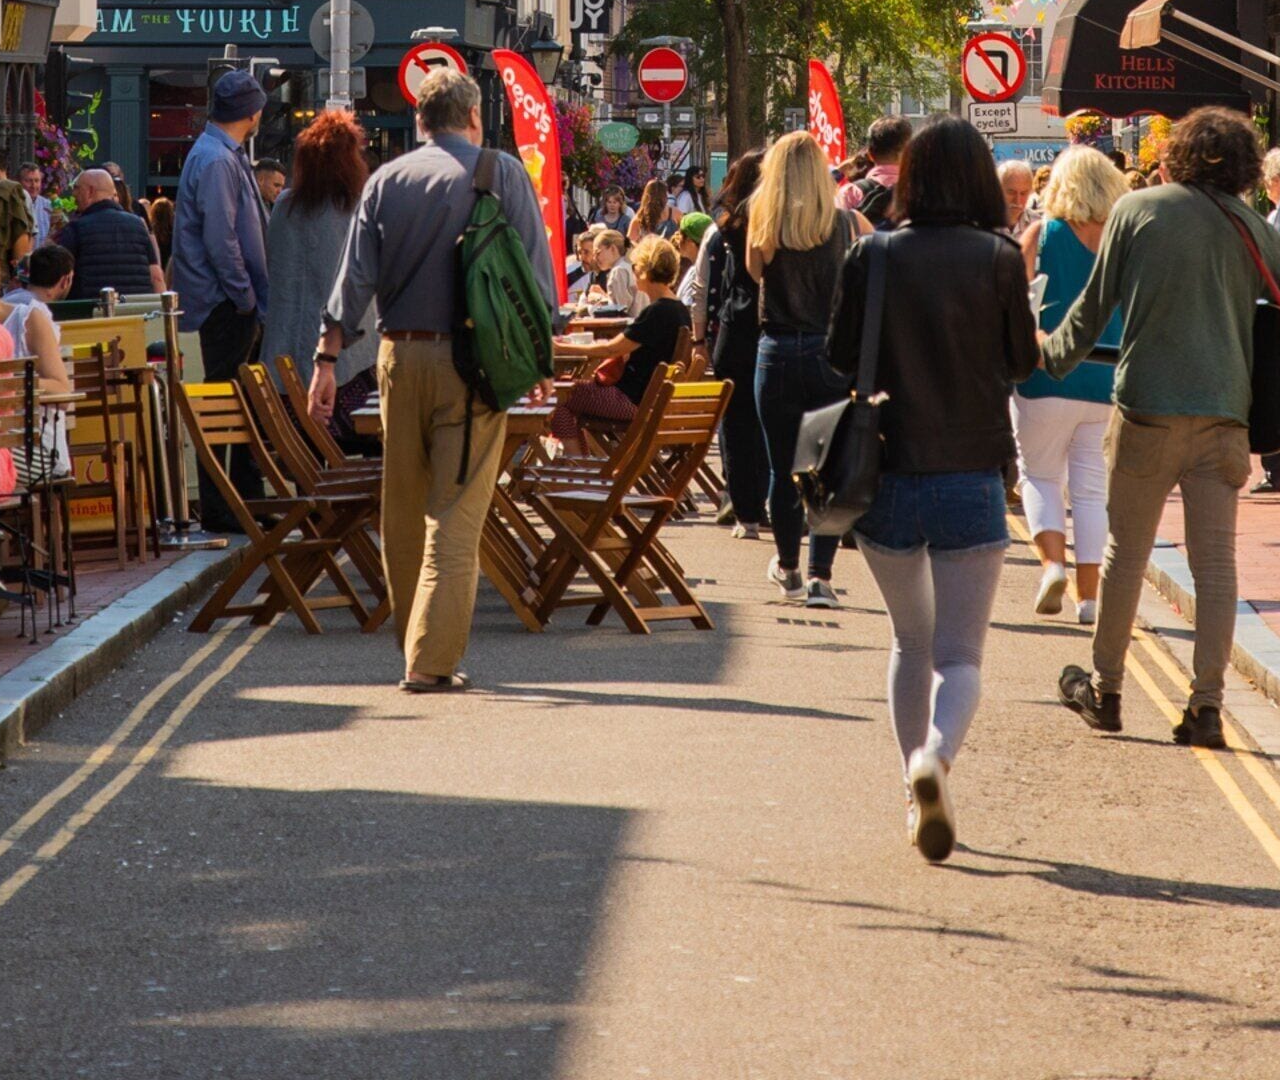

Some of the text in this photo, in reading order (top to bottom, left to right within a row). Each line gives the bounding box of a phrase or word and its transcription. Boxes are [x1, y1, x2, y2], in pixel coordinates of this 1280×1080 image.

[141, 14, 171, 24] THE
[176, 5, 300, 39] FOURTH
[1121, 55, 1176, 72] HELLS
[1094, 73, 1177, 90] KITCHEN
[974, 106, 1011, 118] Except
[976, 120, 1010, 130] cycles
